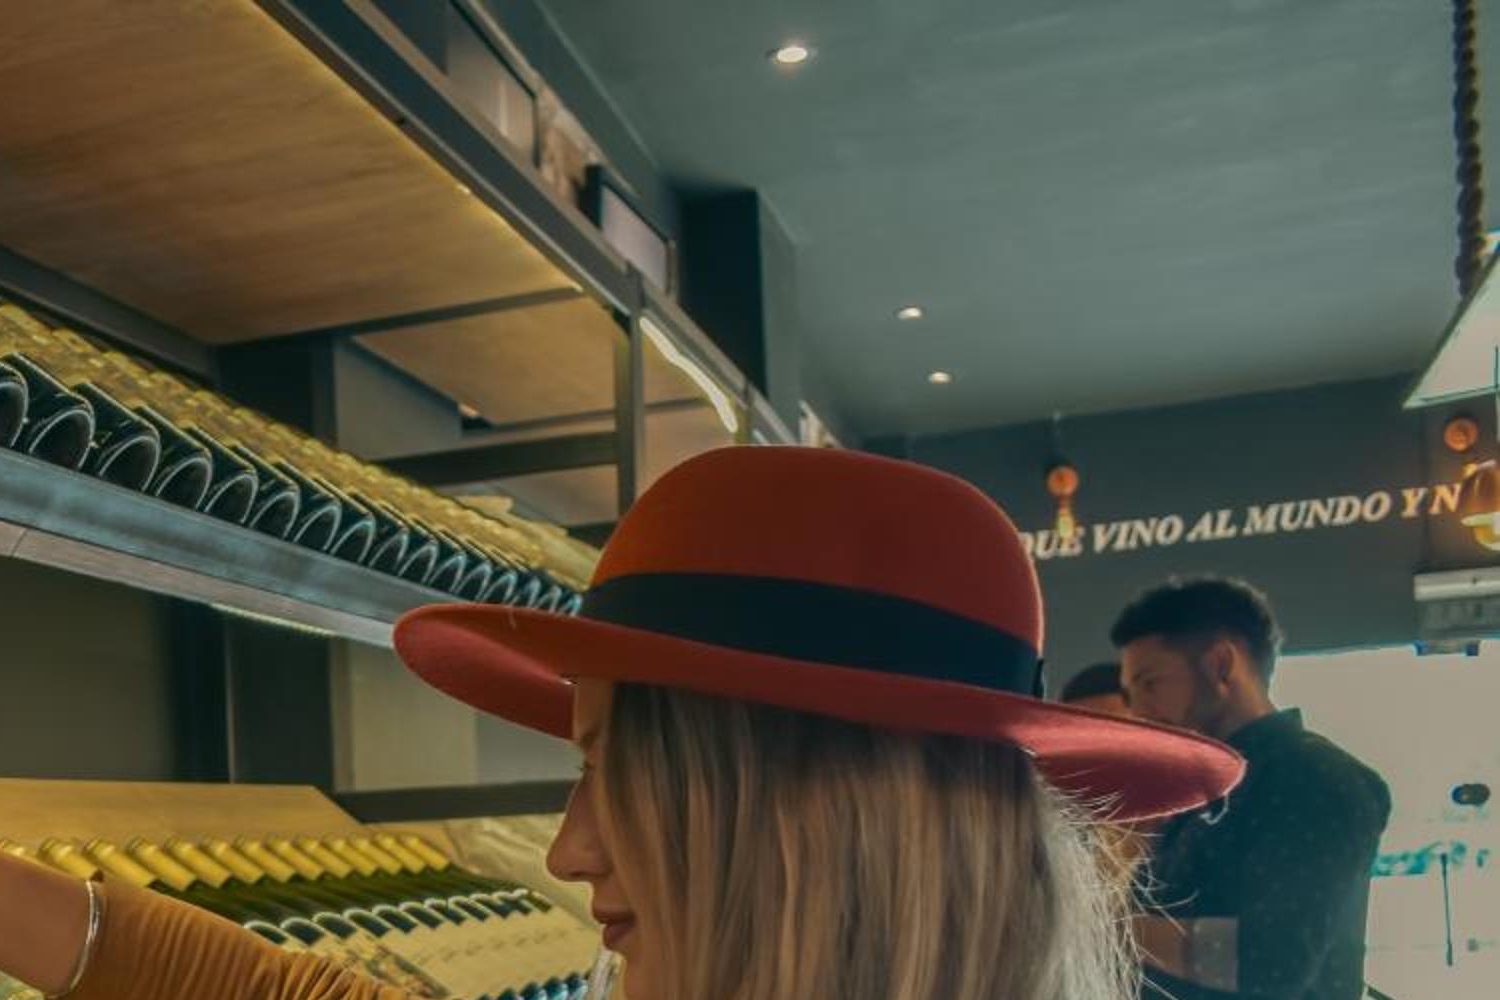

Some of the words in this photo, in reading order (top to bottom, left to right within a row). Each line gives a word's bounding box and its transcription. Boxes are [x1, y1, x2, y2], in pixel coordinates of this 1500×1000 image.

[1092, 514, 1183, 555] VINO
[1187, 511, 1237, 543] AL
[1243, 490, 1391, 536] MUNDO
[1400, 487, 1428, 517] Y
